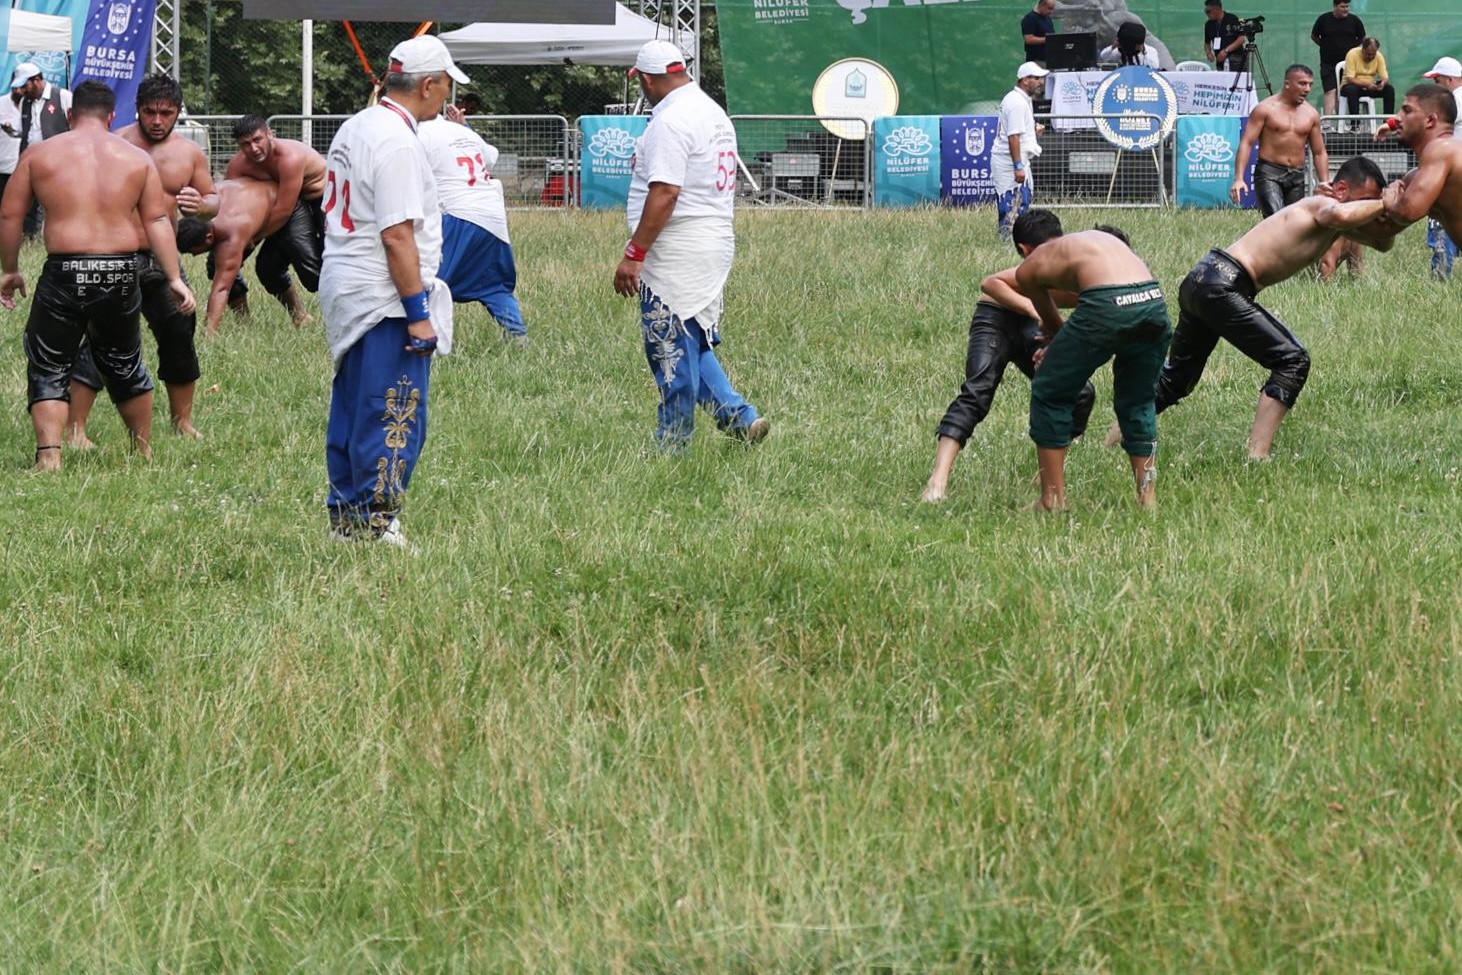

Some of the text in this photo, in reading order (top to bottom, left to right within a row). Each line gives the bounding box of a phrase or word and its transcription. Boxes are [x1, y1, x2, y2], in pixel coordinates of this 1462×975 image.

[754, 7, 809, 19] BELEDİYESİ
[86, 45, 136, 62] BURSA
[82, 67, 133, 80] BELEDİYESİ
[592, 157, 632, 166] NİLÜFE
[887, 157, 929, 165] NİLÜFER
[592, 166, 632, 175] BELEDİYES
[1189, 162, 1230, 171] NİLÜFER
[952, 169, 992, 179] BURS
[952, 186, 995, 195] BELEDİYES
